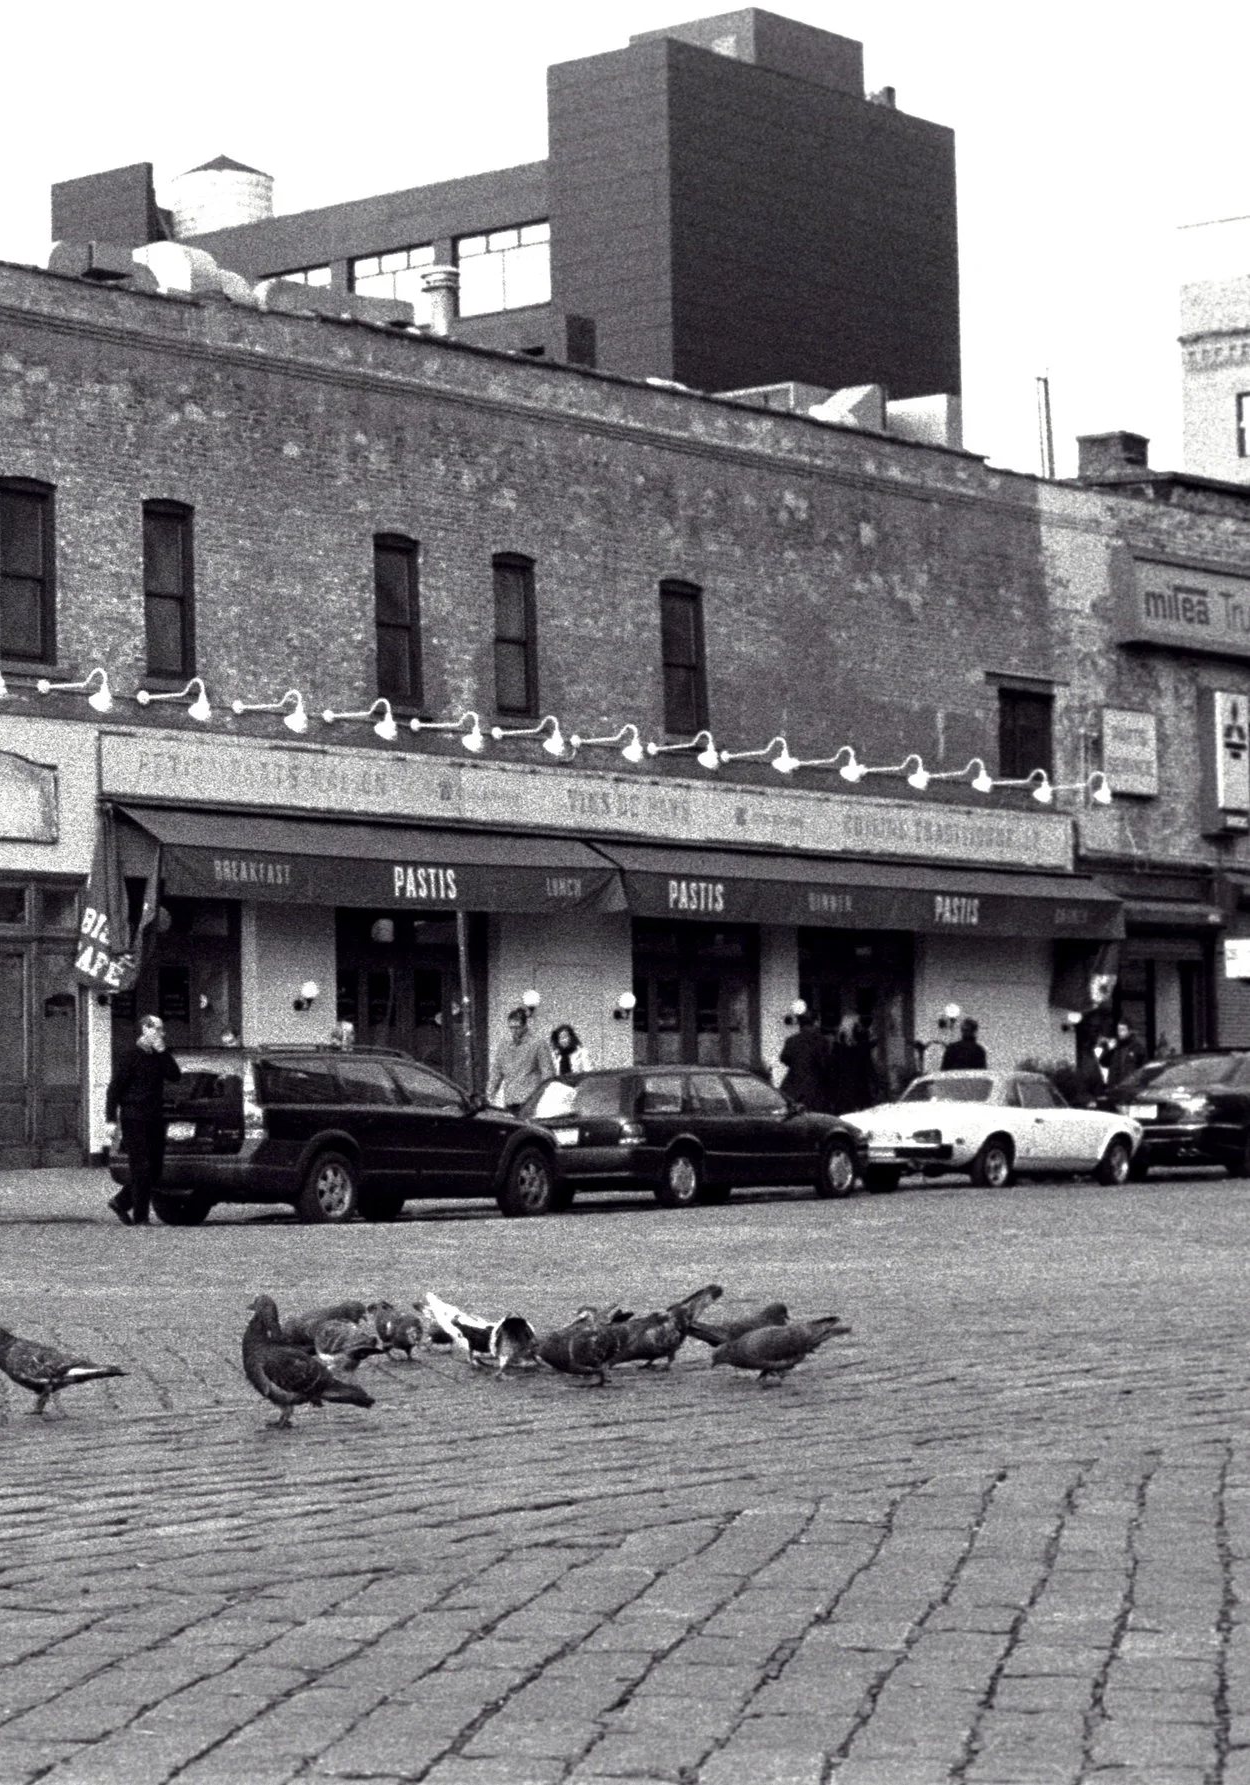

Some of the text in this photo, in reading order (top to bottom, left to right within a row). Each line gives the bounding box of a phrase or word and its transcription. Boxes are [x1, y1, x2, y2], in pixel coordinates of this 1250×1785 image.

[214, 860, 290, 885] BREAKFAST
[394, 866, 458, 899] PASTIS
[668, 880, 725, 911] PASTIS
[934, 895, 980, 925] PASTIS
